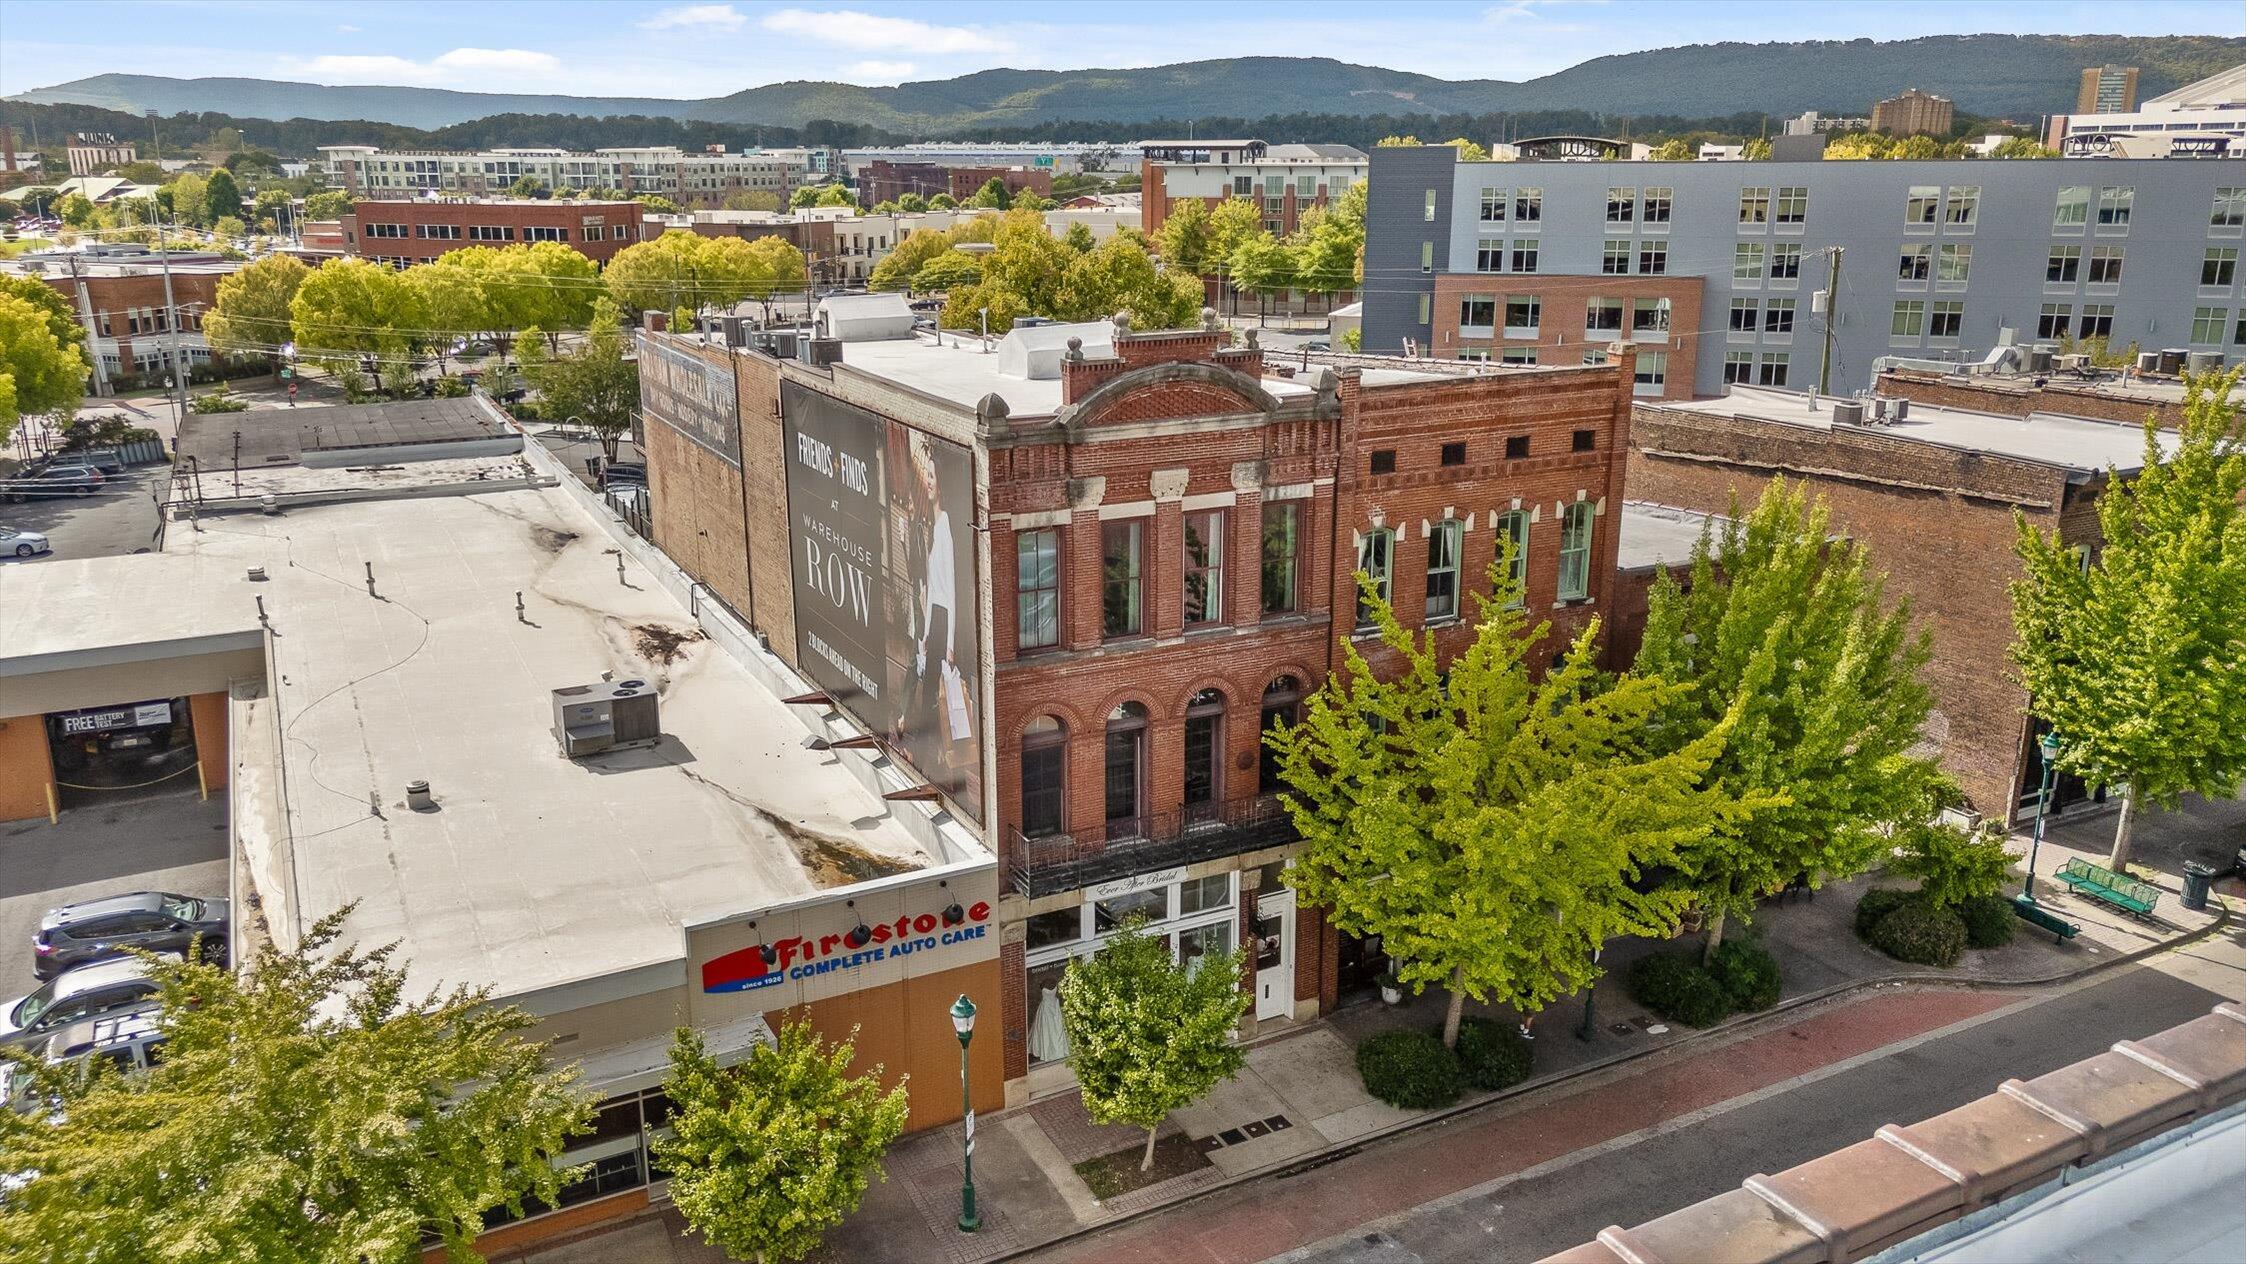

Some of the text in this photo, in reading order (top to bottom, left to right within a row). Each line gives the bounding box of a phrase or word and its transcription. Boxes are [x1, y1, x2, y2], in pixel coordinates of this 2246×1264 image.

[797, 432, 834, 478] FRIENDS
[840, 452, 868, 496] FINDS
[830, 499, 839, 512] AT
[803, 513, 872, 568] WAREHOUSE
[804, 535, 874, 628] ROW
[808, 630, 812, 646] 2
[812, 633, 829, 660] BLOCKS
[829, 647, 844, 672] AHEAD
[851, 665, 862, 688] THE
[862, 673, 878, 701] RIGHT
[65, 715, 96, 732] FREE
[94, 711, 126, 721] BATTERY
[95, 720, 113, 729] TEST
[1096, 883, 1118, 896] Ever
[1147, 871, 1178, 885] Bridal
[790, 948, 885, 980] COMPLETE
[890, 937, 937, 958] AUTO
[742, 976, 783, 990] since 1926
